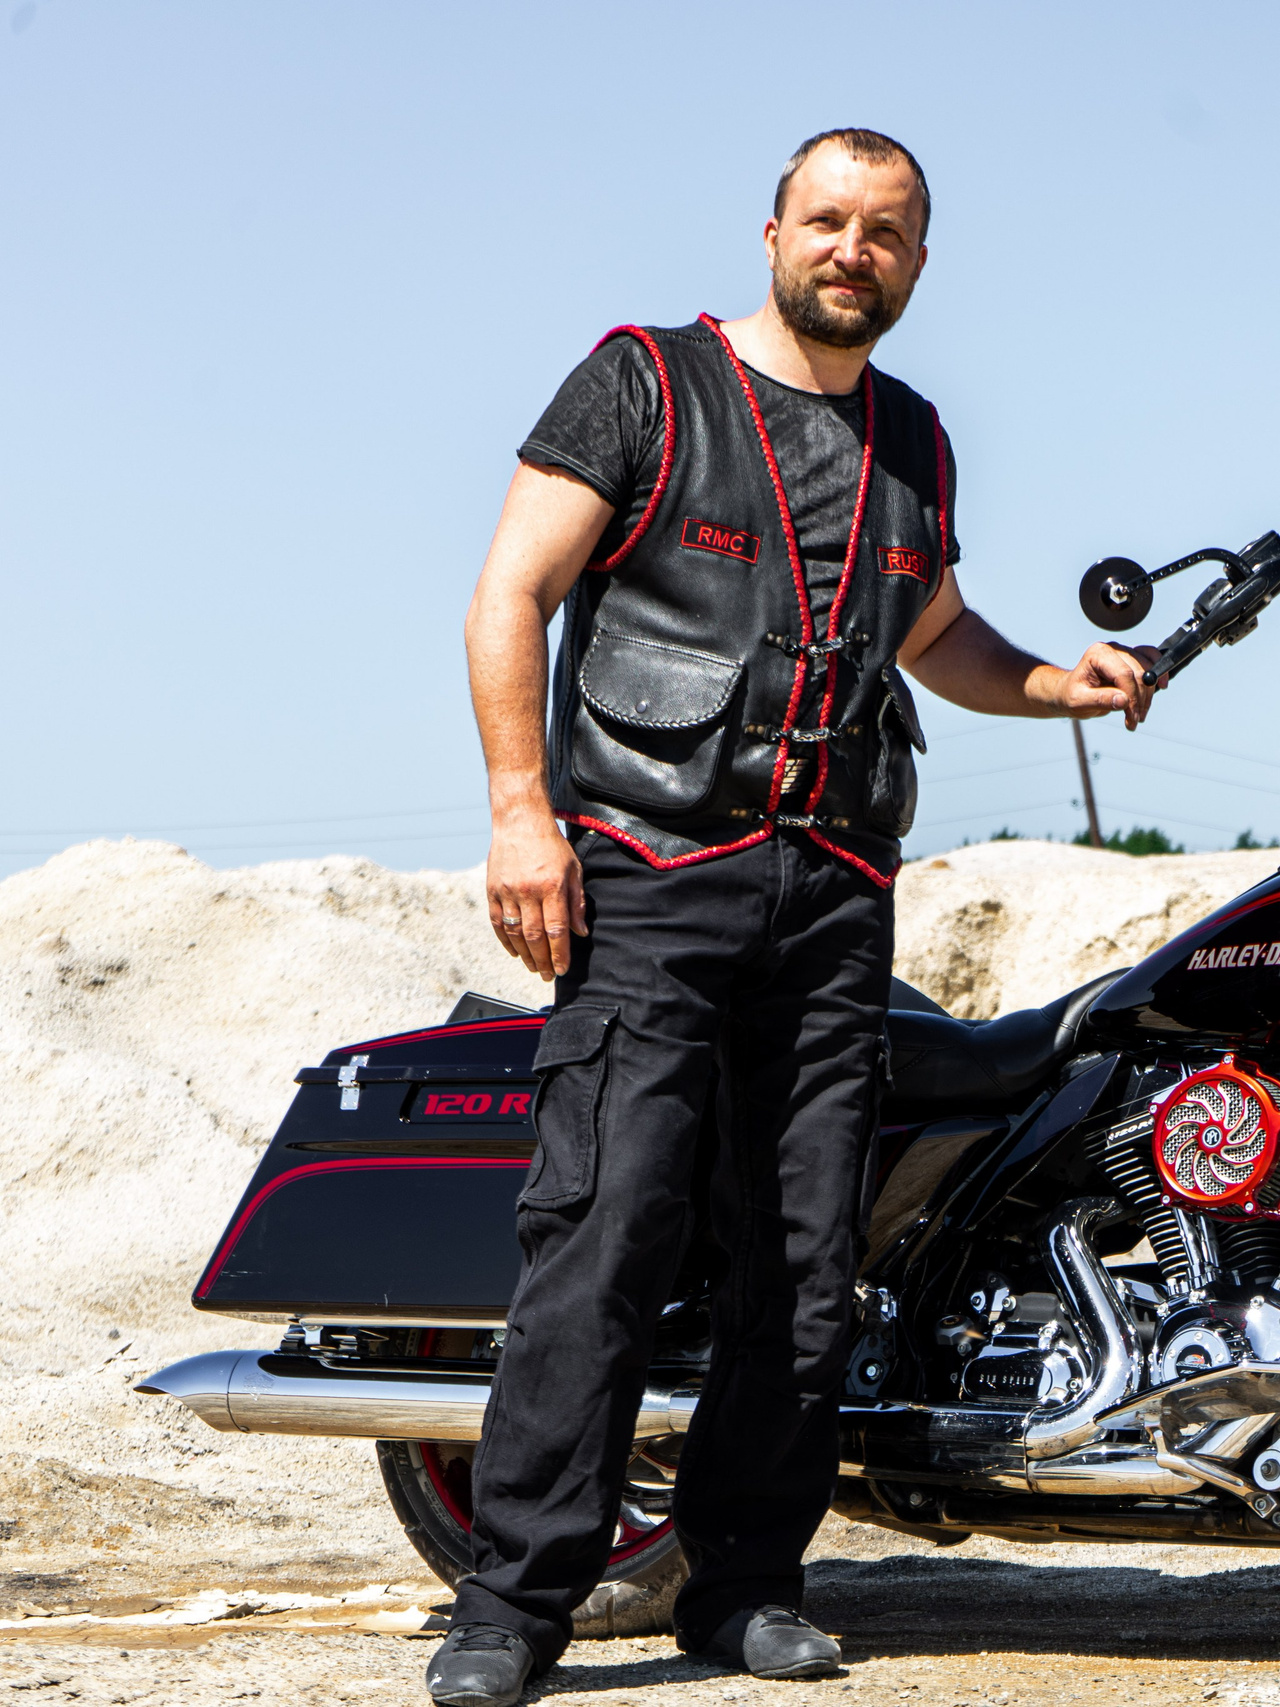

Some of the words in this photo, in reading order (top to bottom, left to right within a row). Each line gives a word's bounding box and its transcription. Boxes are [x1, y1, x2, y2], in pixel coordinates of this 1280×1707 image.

[698, 526, 745, 552] RMC
[424, 1094, 493, 1115] 120
[498, 1093, 532, 1115] R
